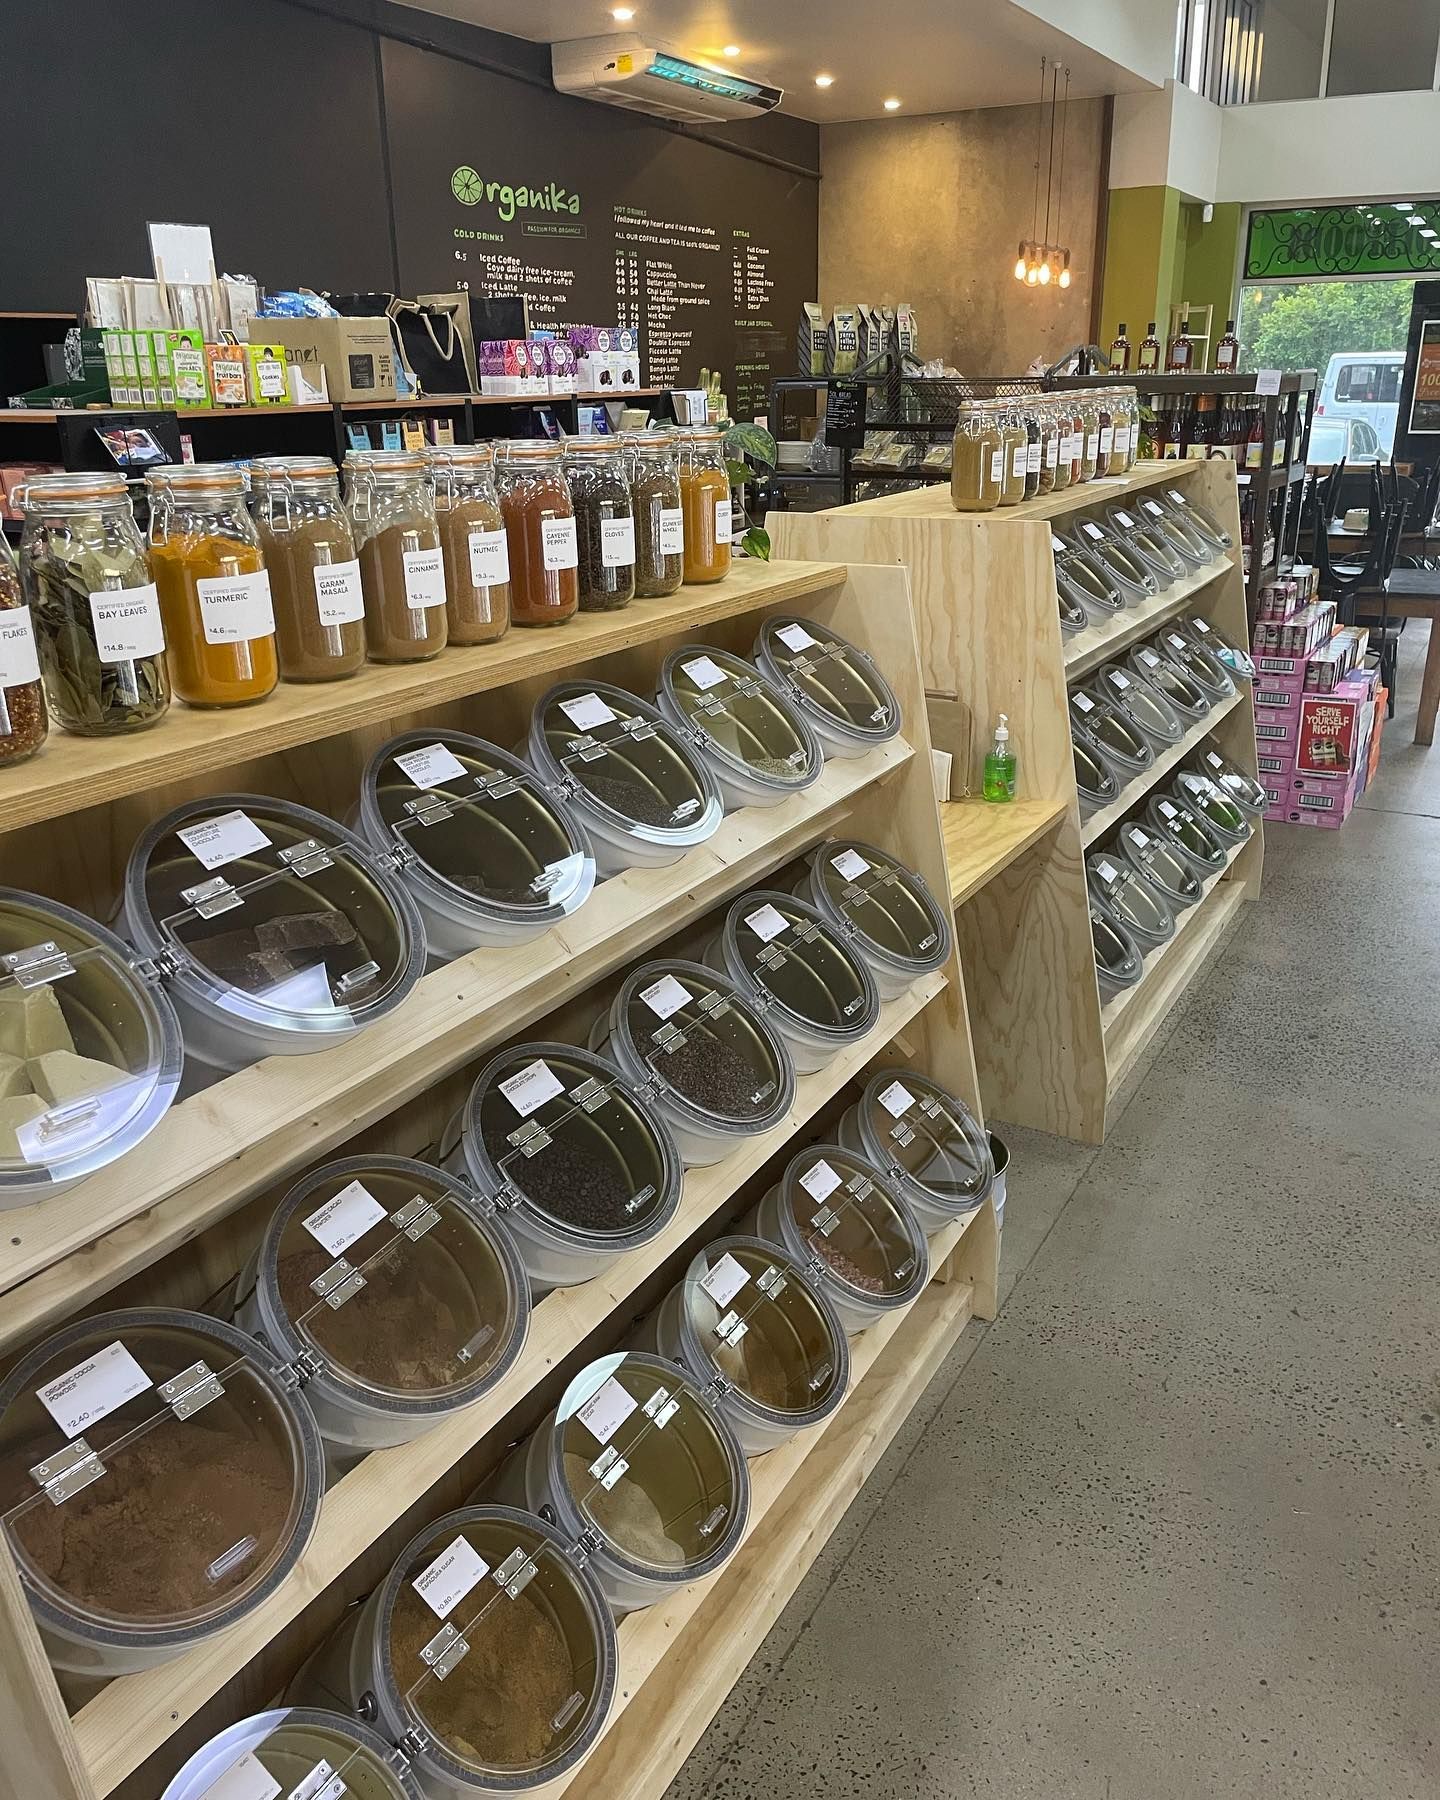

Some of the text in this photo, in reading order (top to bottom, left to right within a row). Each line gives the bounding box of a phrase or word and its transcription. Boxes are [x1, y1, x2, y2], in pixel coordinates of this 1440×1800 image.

[617, 215, 640, 225] followed
[641, 219, 650, 228] my
[650, 220, 664, 229] heart
[664, 222, 674, 230] and
[454, 228, 504, 242] COLD DRINKS
[615, 232, 625, 240] ALL
[626, 233, 638, 241] OUR
[639, 234, 659, 244] COFFEE
[659, 236, 670, 245] AND
[671, 238, 680, 246] TEA
[454, 250, 520, 266] 6.5 Iced Coffee
[487, 263, 505, 274] Coyo
[507, 264, 524, 275] dairy
[525, 266, 539, 275] free
[646, 261, 657, 269] Flat
[657, 261, 672, 270] White
[487, 272, 573, 286] milk and 2 shots of coffee
[646, 269, 677, 280] Cappuccino
[481, 281, 498, 291] Iced
[499, 283, 518, 292] Latte
[646, 278, 664, 287] Better
[664, 280, 677, 288] Latte
[691, 282, 706, 290] Never
[647, 287, 659, 295] Chai
[660, 288, 673, 296] Latte
[552, 295, 567, 303] milk
[679, 297, 697, 305] ground
[535, 303, 556, 312] Coffee
[647, 304, 661, 313] Long
[661, 304, 676, 312] Black
[647, 312, 658, 320] Hot
[658, 312, 672, 320] Choc
[537, 321, 559, 330] Health
[648, 321, 666, 329] Mocha
[648, 330, 693, 339] Espresso yourself
[648, 338, 691, 347] Double Espresso
[546, 532, 571, 540] CAYENNE
[473, 546, 498, 555] NUTMEG
[408, 564, 439, 574] CINNAMON
[319, 579, 345, 589] GARAM
[320, 586, 349, 597] MASALA
[204, 592, 249, 604] TURMERIC
[99, 606, 148, 620] BAY LEAVES
[3, 627, 28, 640] FLAKES
[1316, 706, 1342, 717] SERVE
[1306, 715, 1350, 727] YOURSELF
[1312, 724, 1342, 736] RIGHT
[184, 826, 207, 838] ORGANIC
[192, 834, 221, 848] CHOCOLATE
[308, 1210, 329, 1227] ORGANIC
[312, 1214, 332, 1231] POWDER
[44, 1363, 97, 1398] ORGANIC COCOA
[48, 1382, 78, 1403] POWDER
[441, 1555, 455, 1571] SUGAR
[418, 1568, 437, 1588] ORGANIC
